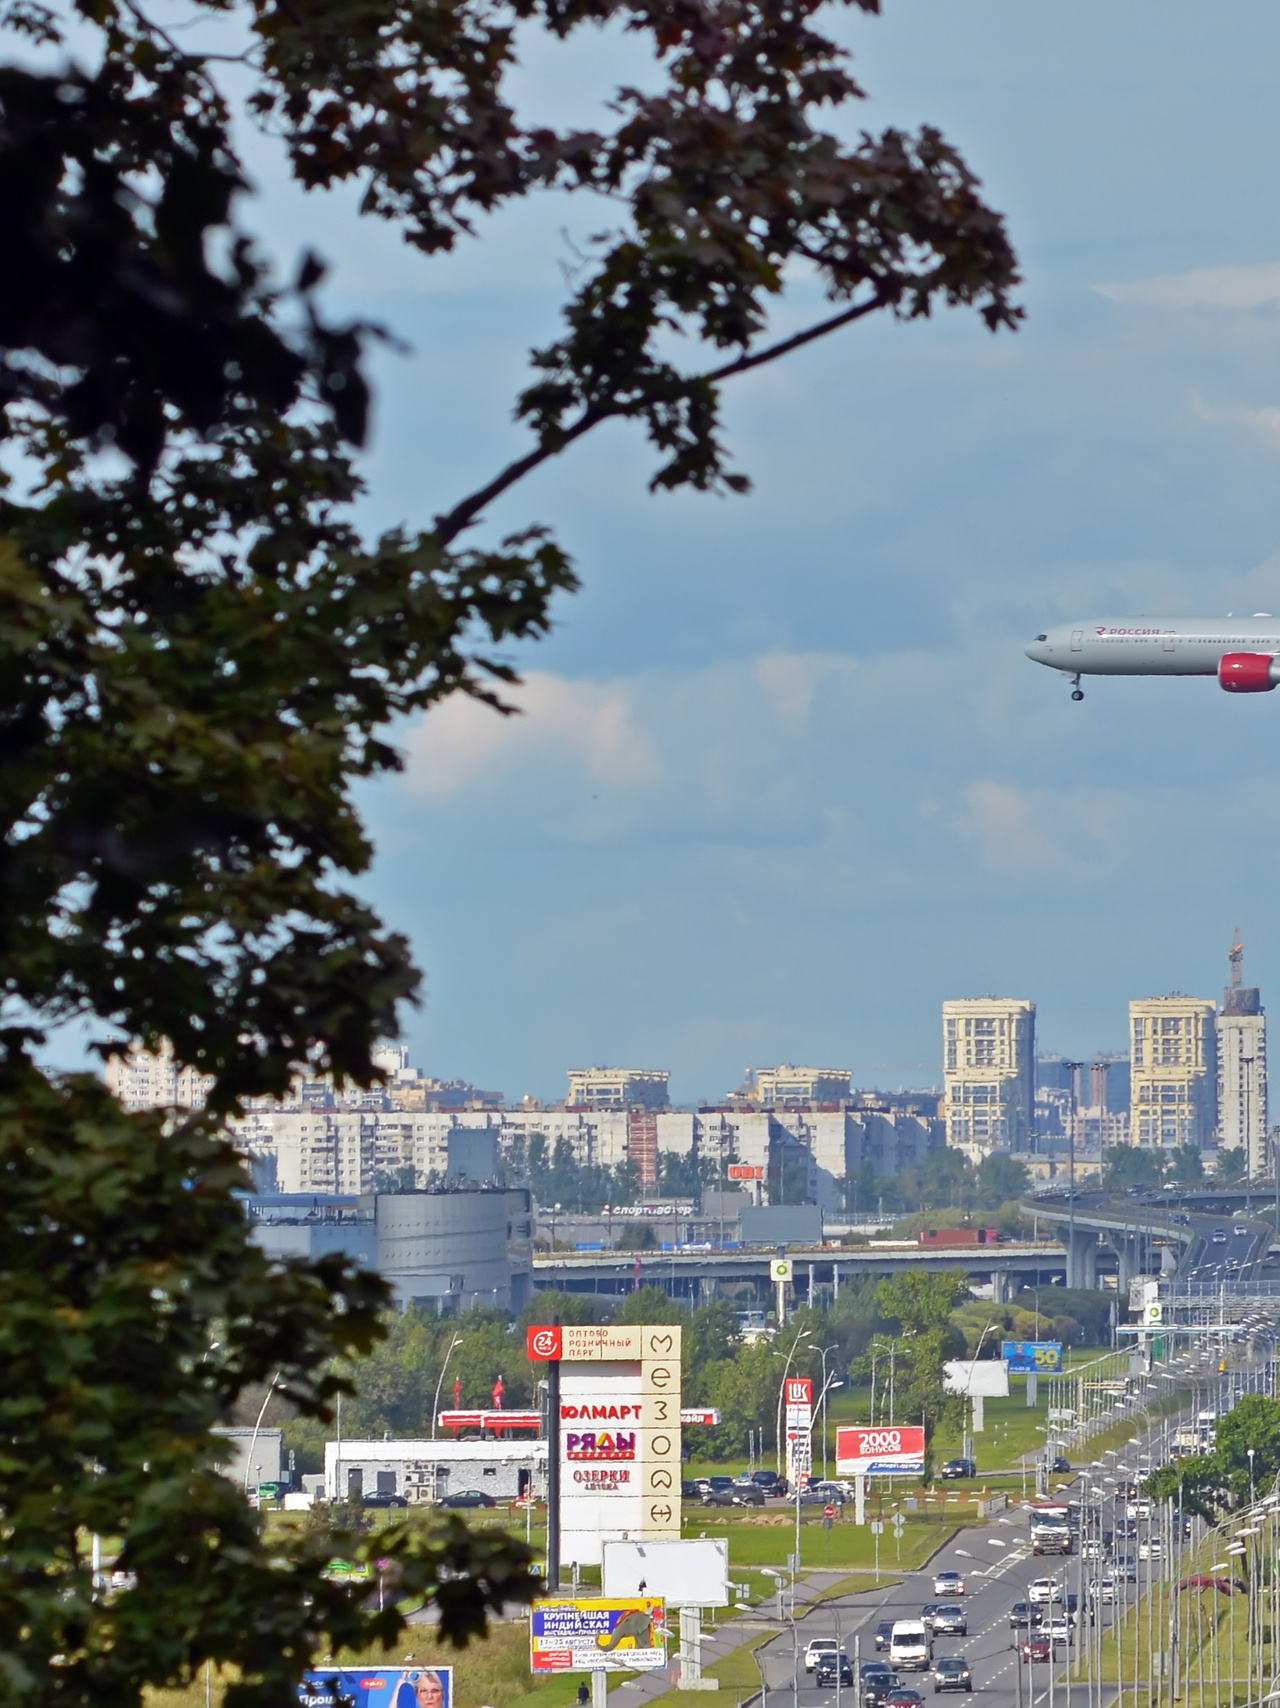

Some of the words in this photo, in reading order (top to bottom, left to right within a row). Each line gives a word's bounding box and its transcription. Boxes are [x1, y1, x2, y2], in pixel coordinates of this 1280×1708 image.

[729, 1166, 764, 1179] OBI
[538, 1336, 552, 1346] 24
[569, 1338, 631, 1347] РОЗНИЧНЫЙ
[569, 1349, 594, 1357] ПАРК
[1035, 1350, 1058, 1364] 50
[561, 1405, 642, 1419] ЮЛМАРТ
[567, 1432, 636, 1450] РЯДЫ
[858, 1430, 901, 1448] 2000
[860, 1444, 901, 1455] БОНУСОВ
[573, 1470, 630, 1483] ОЗЕРКИ
[543, 1610, 609, 1620] КРУПНЕЙШАЯ
[543, 1619, 609, 1630] ИНДИЙСКАЯ
